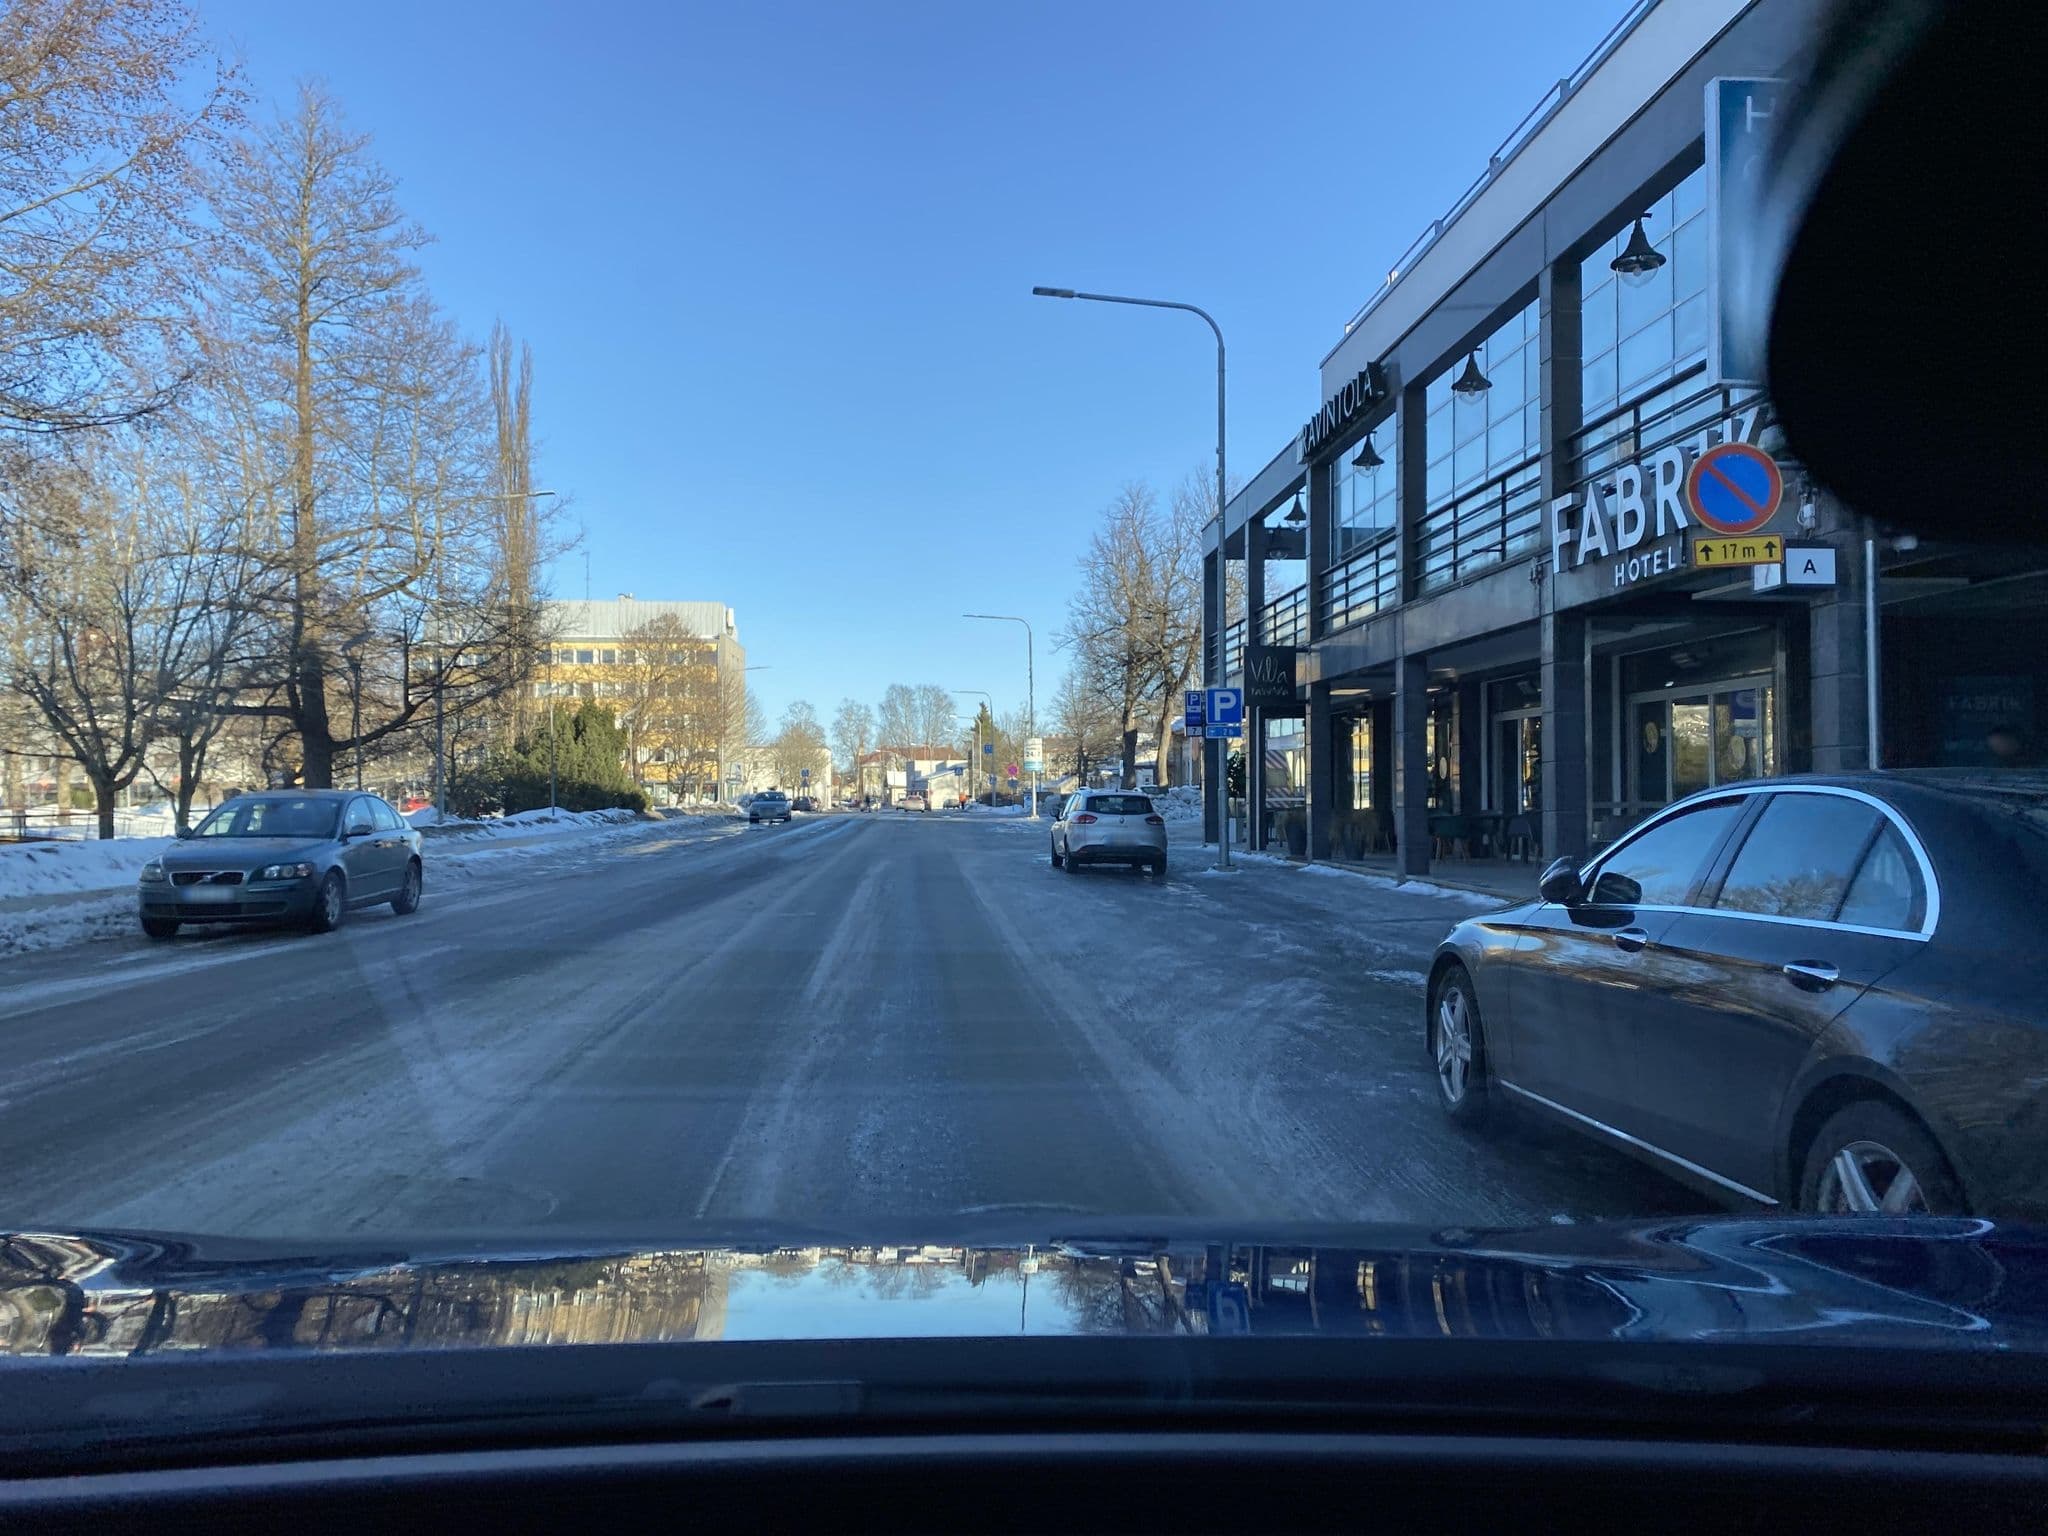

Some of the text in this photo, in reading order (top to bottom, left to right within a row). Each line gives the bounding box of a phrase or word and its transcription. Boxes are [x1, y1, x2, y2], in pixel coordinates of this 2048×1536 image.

[1615, 546, 1677, 587] HOTEL
[1803, 558, 1816, 574] A
[1190, 694, 1198, 705] P
[1214, 691, 1236, 721] P
